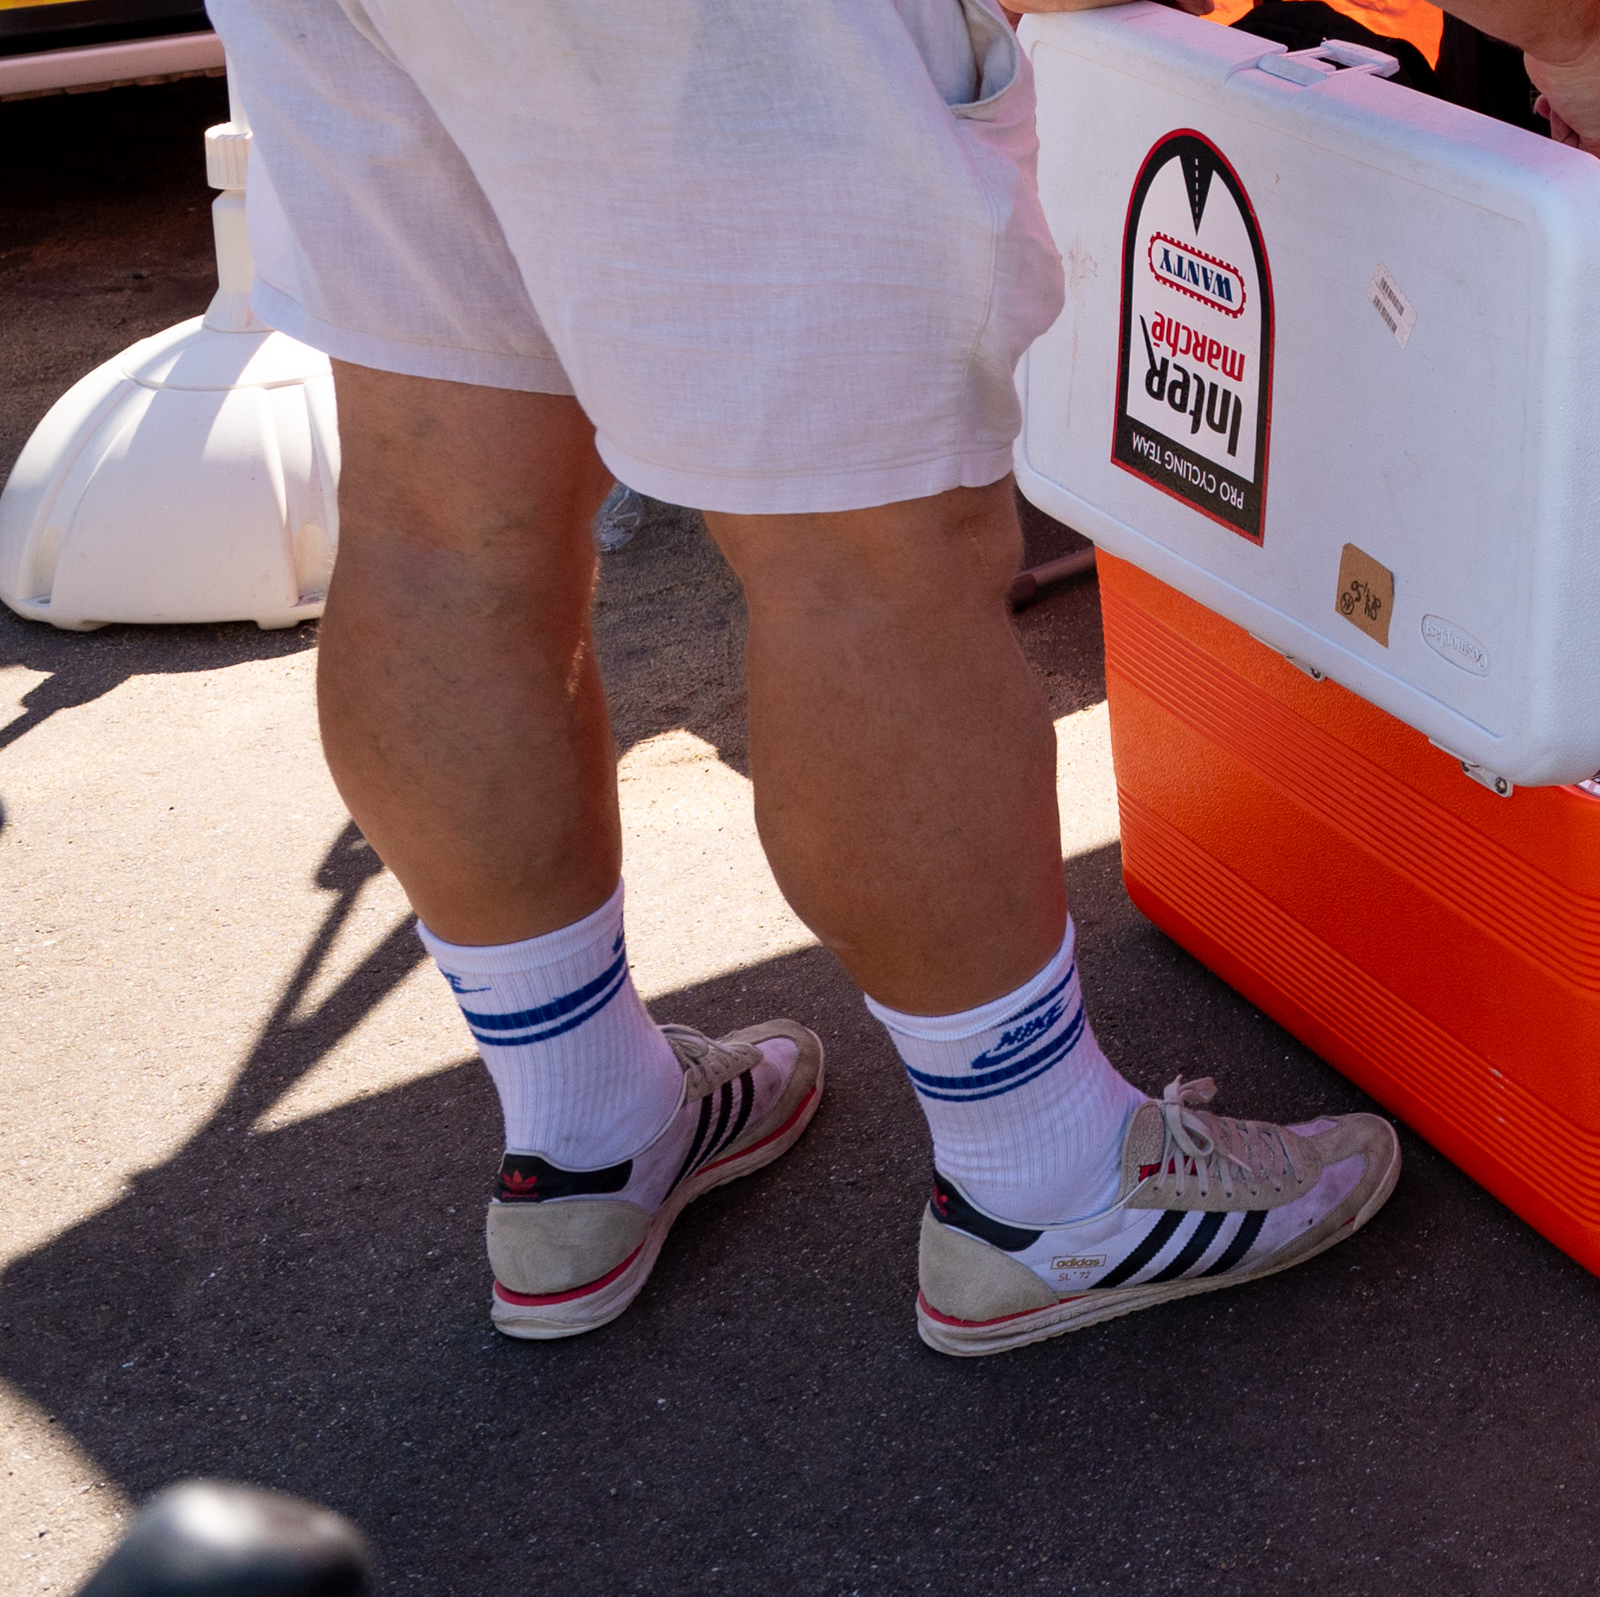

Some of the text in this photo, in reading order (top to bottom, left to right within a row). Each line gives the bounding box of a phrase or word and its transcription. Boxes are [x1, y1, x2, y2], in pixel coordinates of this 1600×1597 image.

[1159, 247, 1234, 304] WANTY
[1151, 310, 1246, 383] marché
[1138, 314, 1243, 458] Inter
[1132, 431, 1245, 510] PRO CYCLING TEAM
[1056, 1256, 1101, 1268] adidas
[1058, 1271, 1073, 1282] SL
